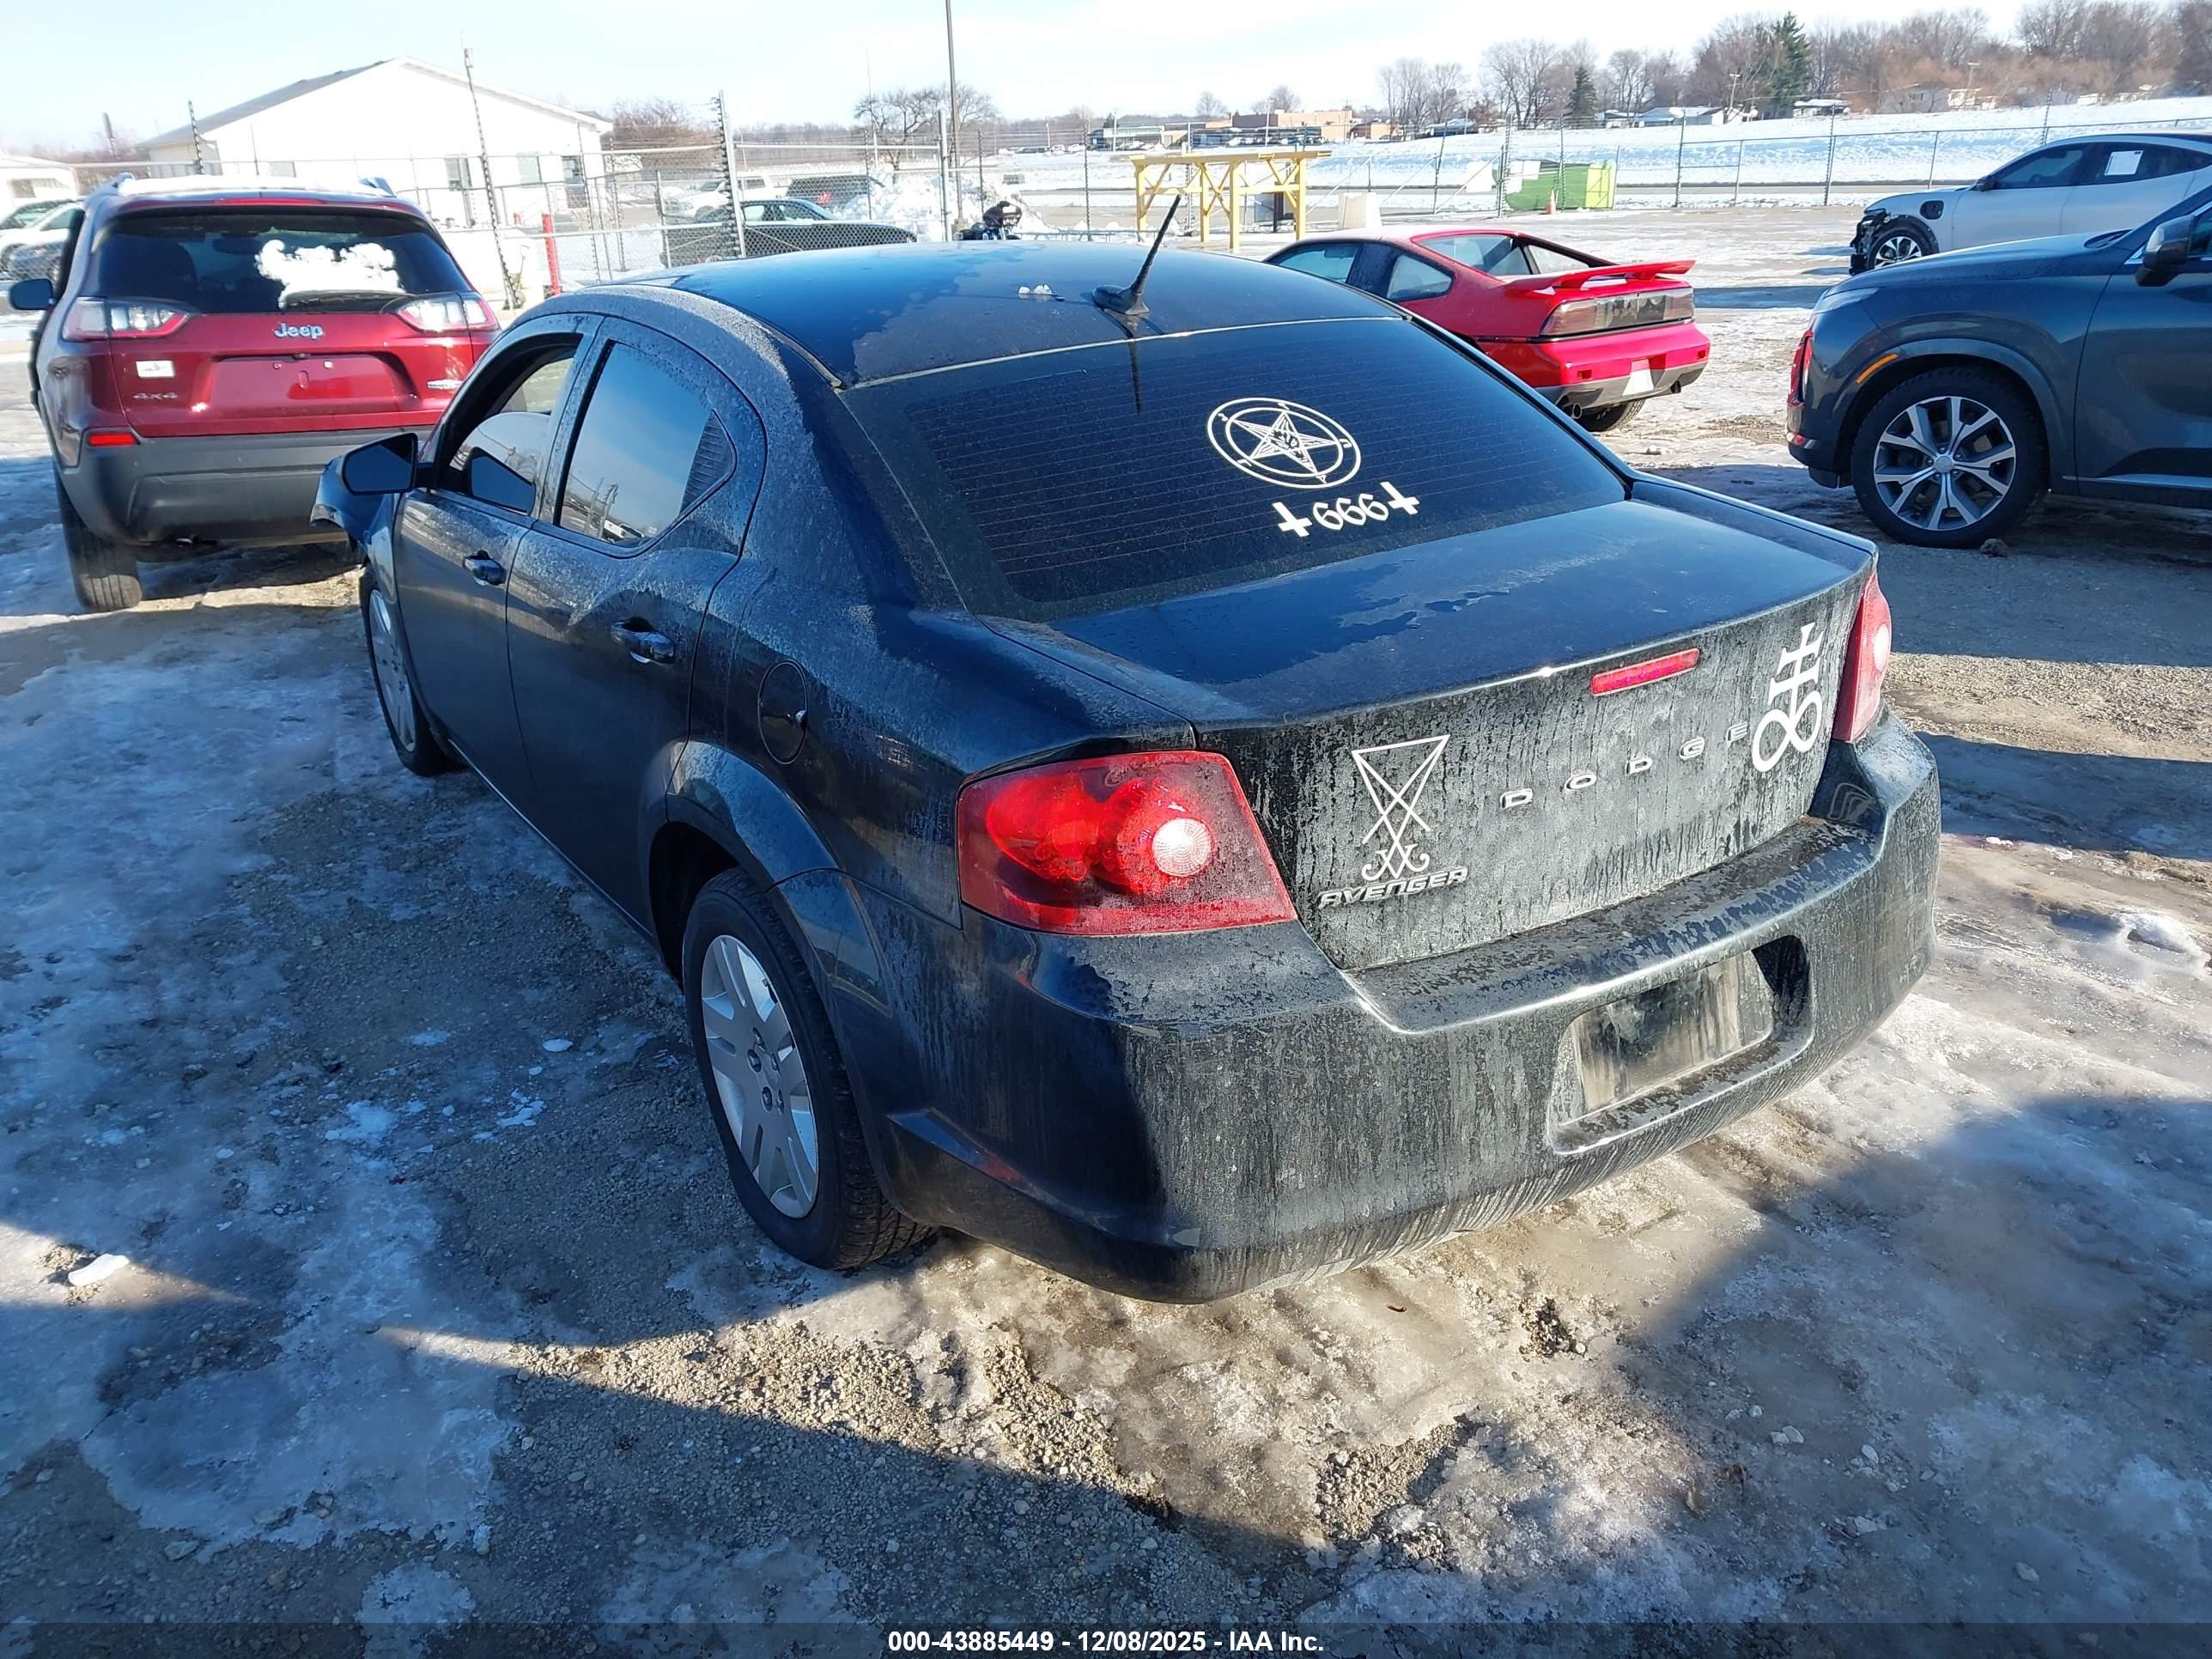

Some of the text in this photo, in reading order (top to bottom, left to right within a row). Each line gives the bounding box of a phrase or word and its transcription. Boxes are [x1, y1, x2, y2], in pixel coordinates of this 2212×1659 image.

[274, 322, 324, 340] Jeep
[1312, 493, 1389, 531] 666
[1499, 722, 1749, 809] DODGE
[1317, 866, 1468, 909] AVENGER
